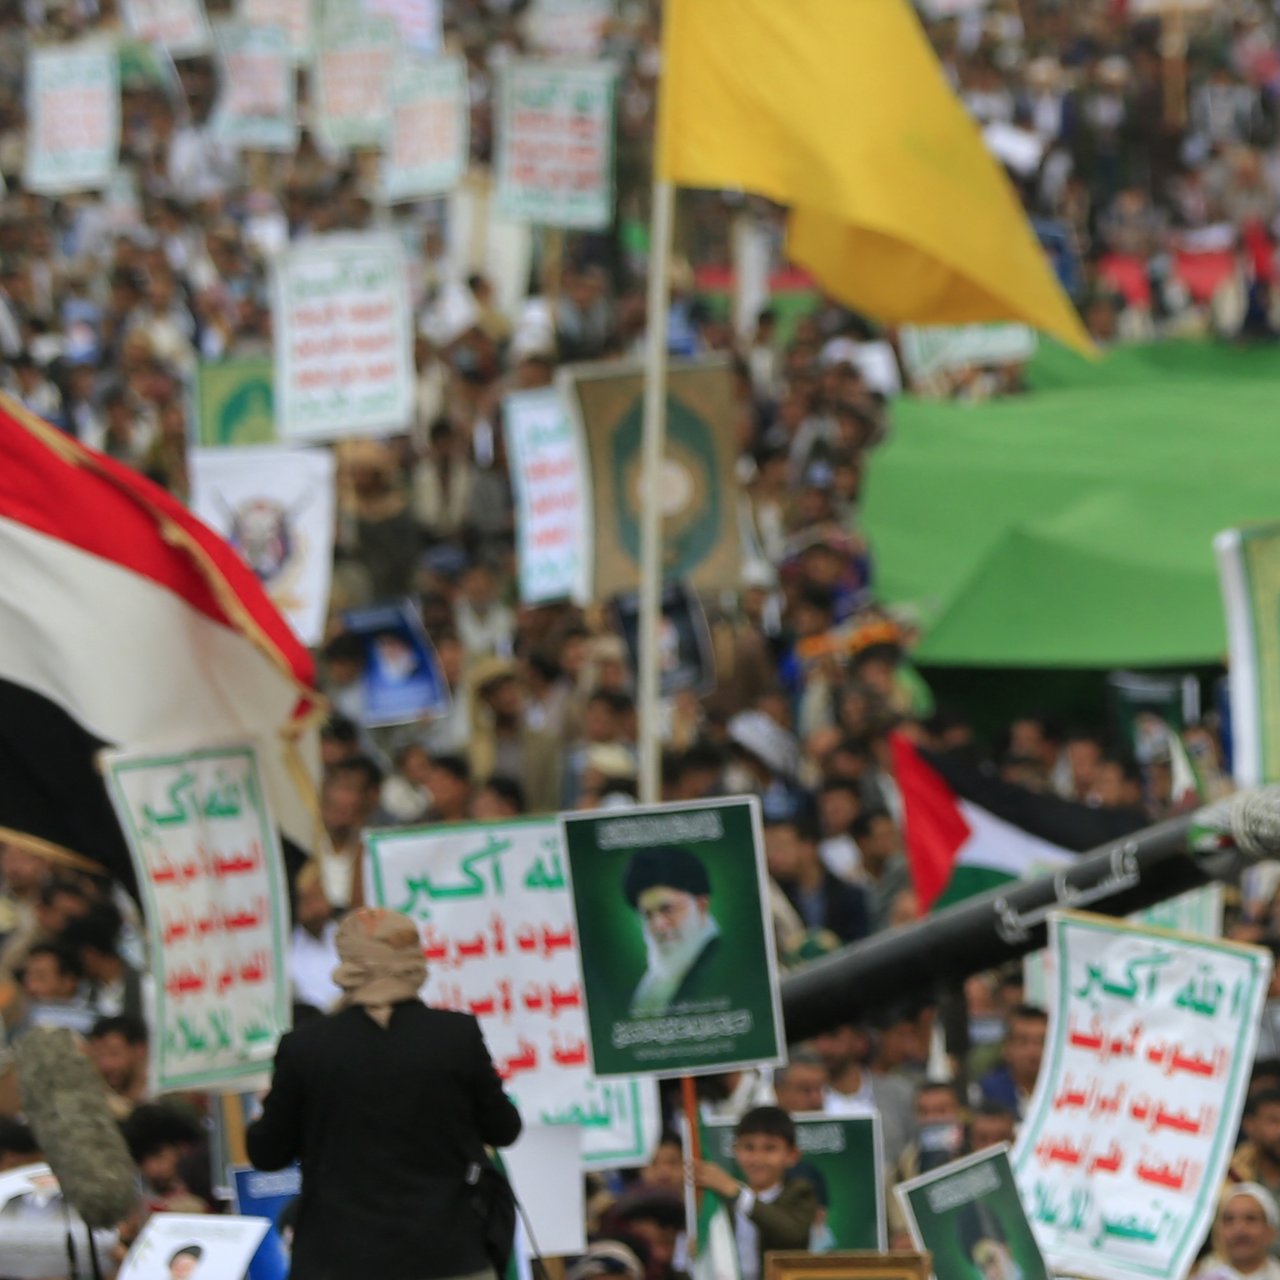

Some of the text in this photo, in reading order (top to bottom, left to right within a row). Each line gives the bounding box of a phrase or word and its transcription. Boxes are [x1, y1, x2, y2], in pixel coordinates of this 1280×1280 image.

[1073, 948, 1246, 1020] الله أكبر
[1147, 1042, 1231, 1083] الموت
[1131, 1097, 1219, 1142] الموت
